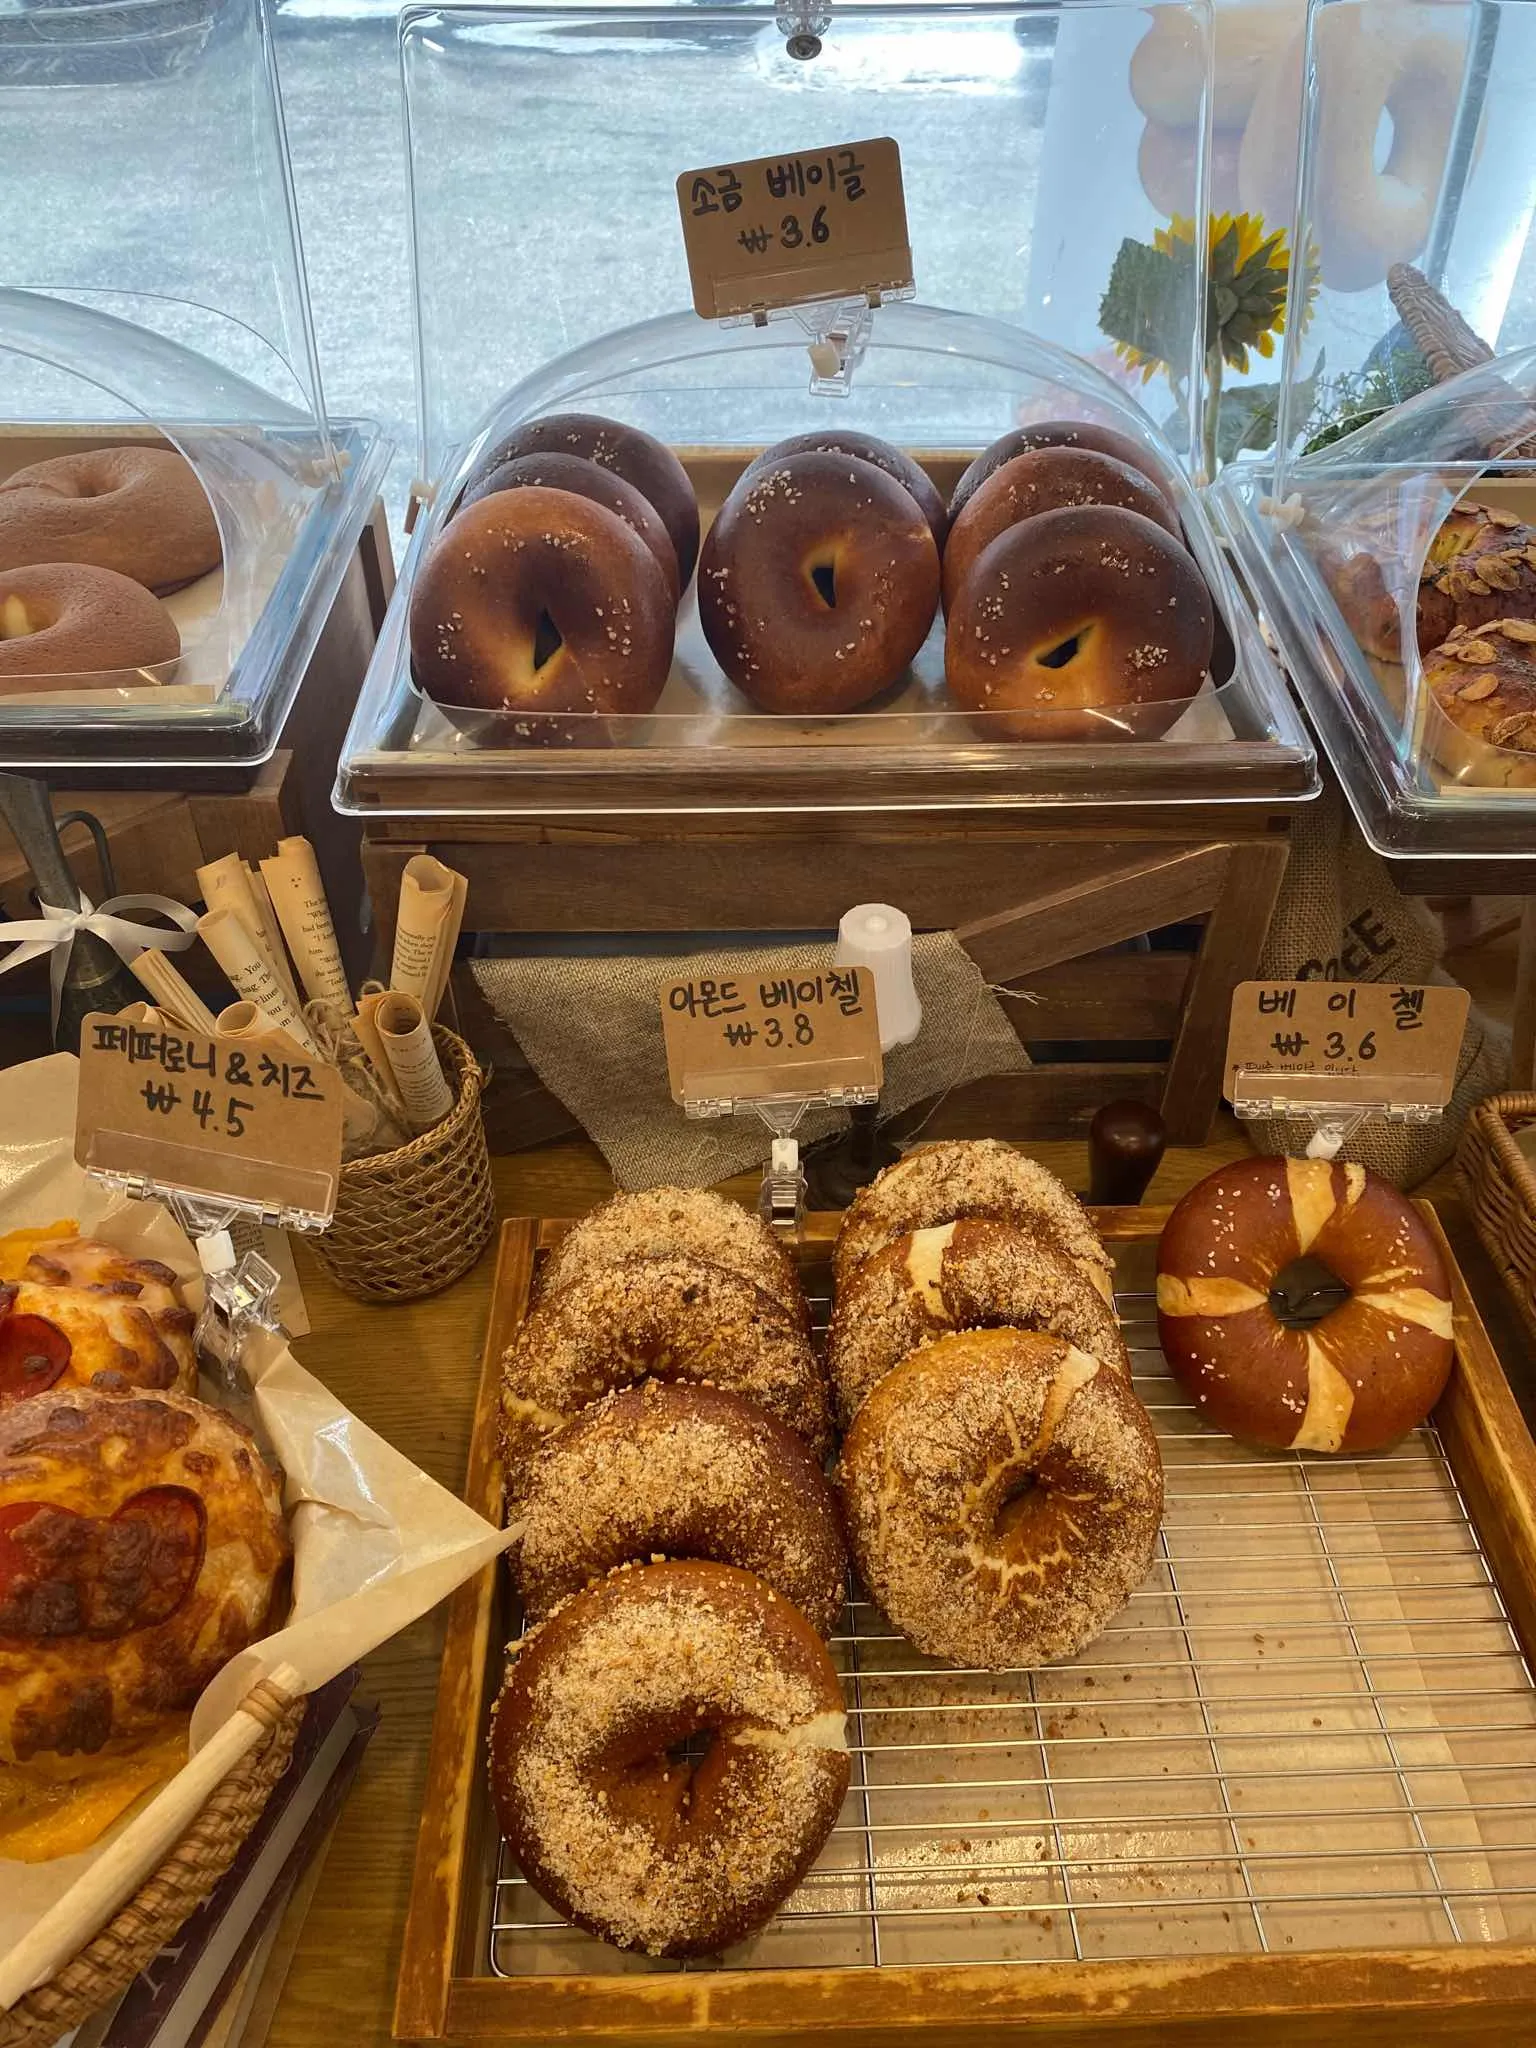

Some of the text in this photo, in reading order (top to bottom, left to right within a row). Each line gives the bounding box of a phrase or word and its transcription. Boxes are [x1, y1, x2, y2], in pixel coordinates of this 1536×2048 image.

[691, 149, 867, 217] 소금 베이글
[669, 968, 863, 1018] 아몬드 베이첼
